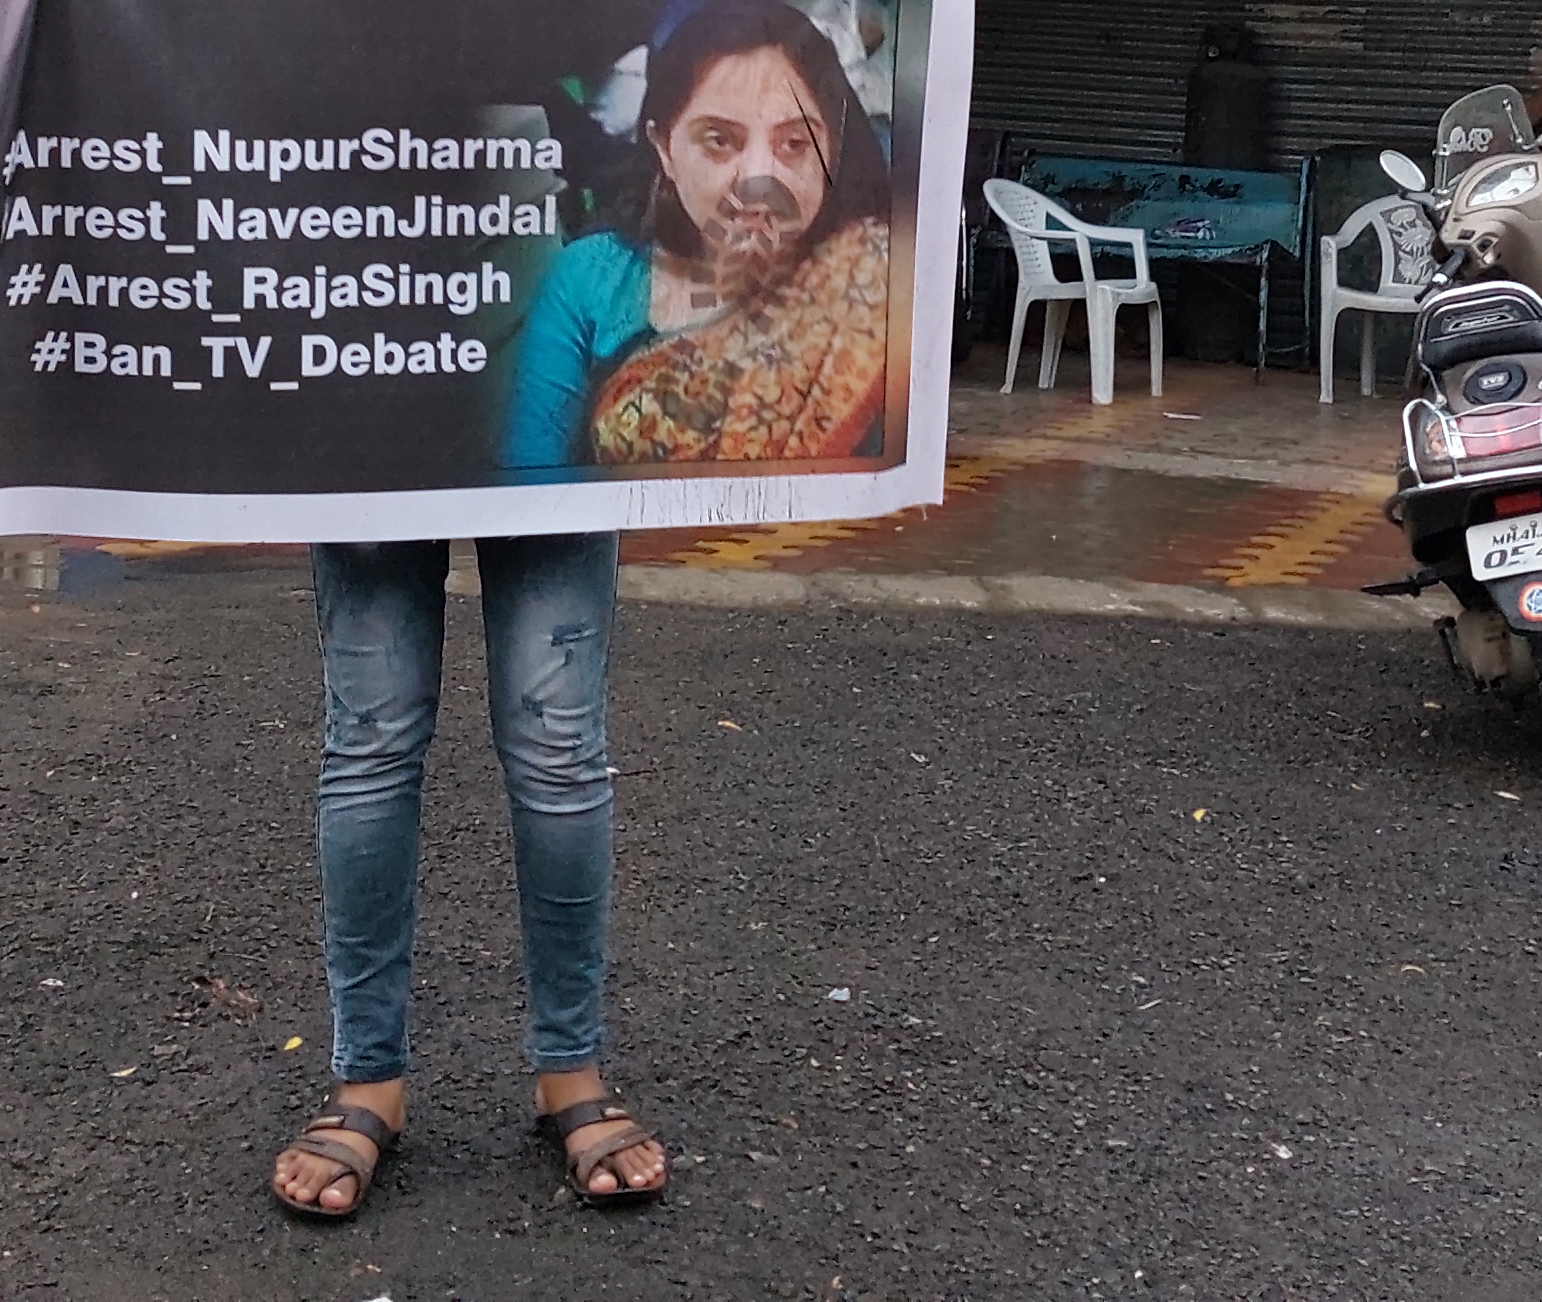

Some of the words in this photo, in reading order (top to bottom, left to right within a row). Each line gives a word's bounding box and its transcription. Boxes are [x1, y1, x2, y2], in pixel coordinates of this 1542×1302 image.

[0, 194, 557, 254] Arrest_NaveenJindal
[5, 261, 511, 323] #Arrest_RajaSingh
[30, 330, 488, 391] #Ban_TV_Debate
